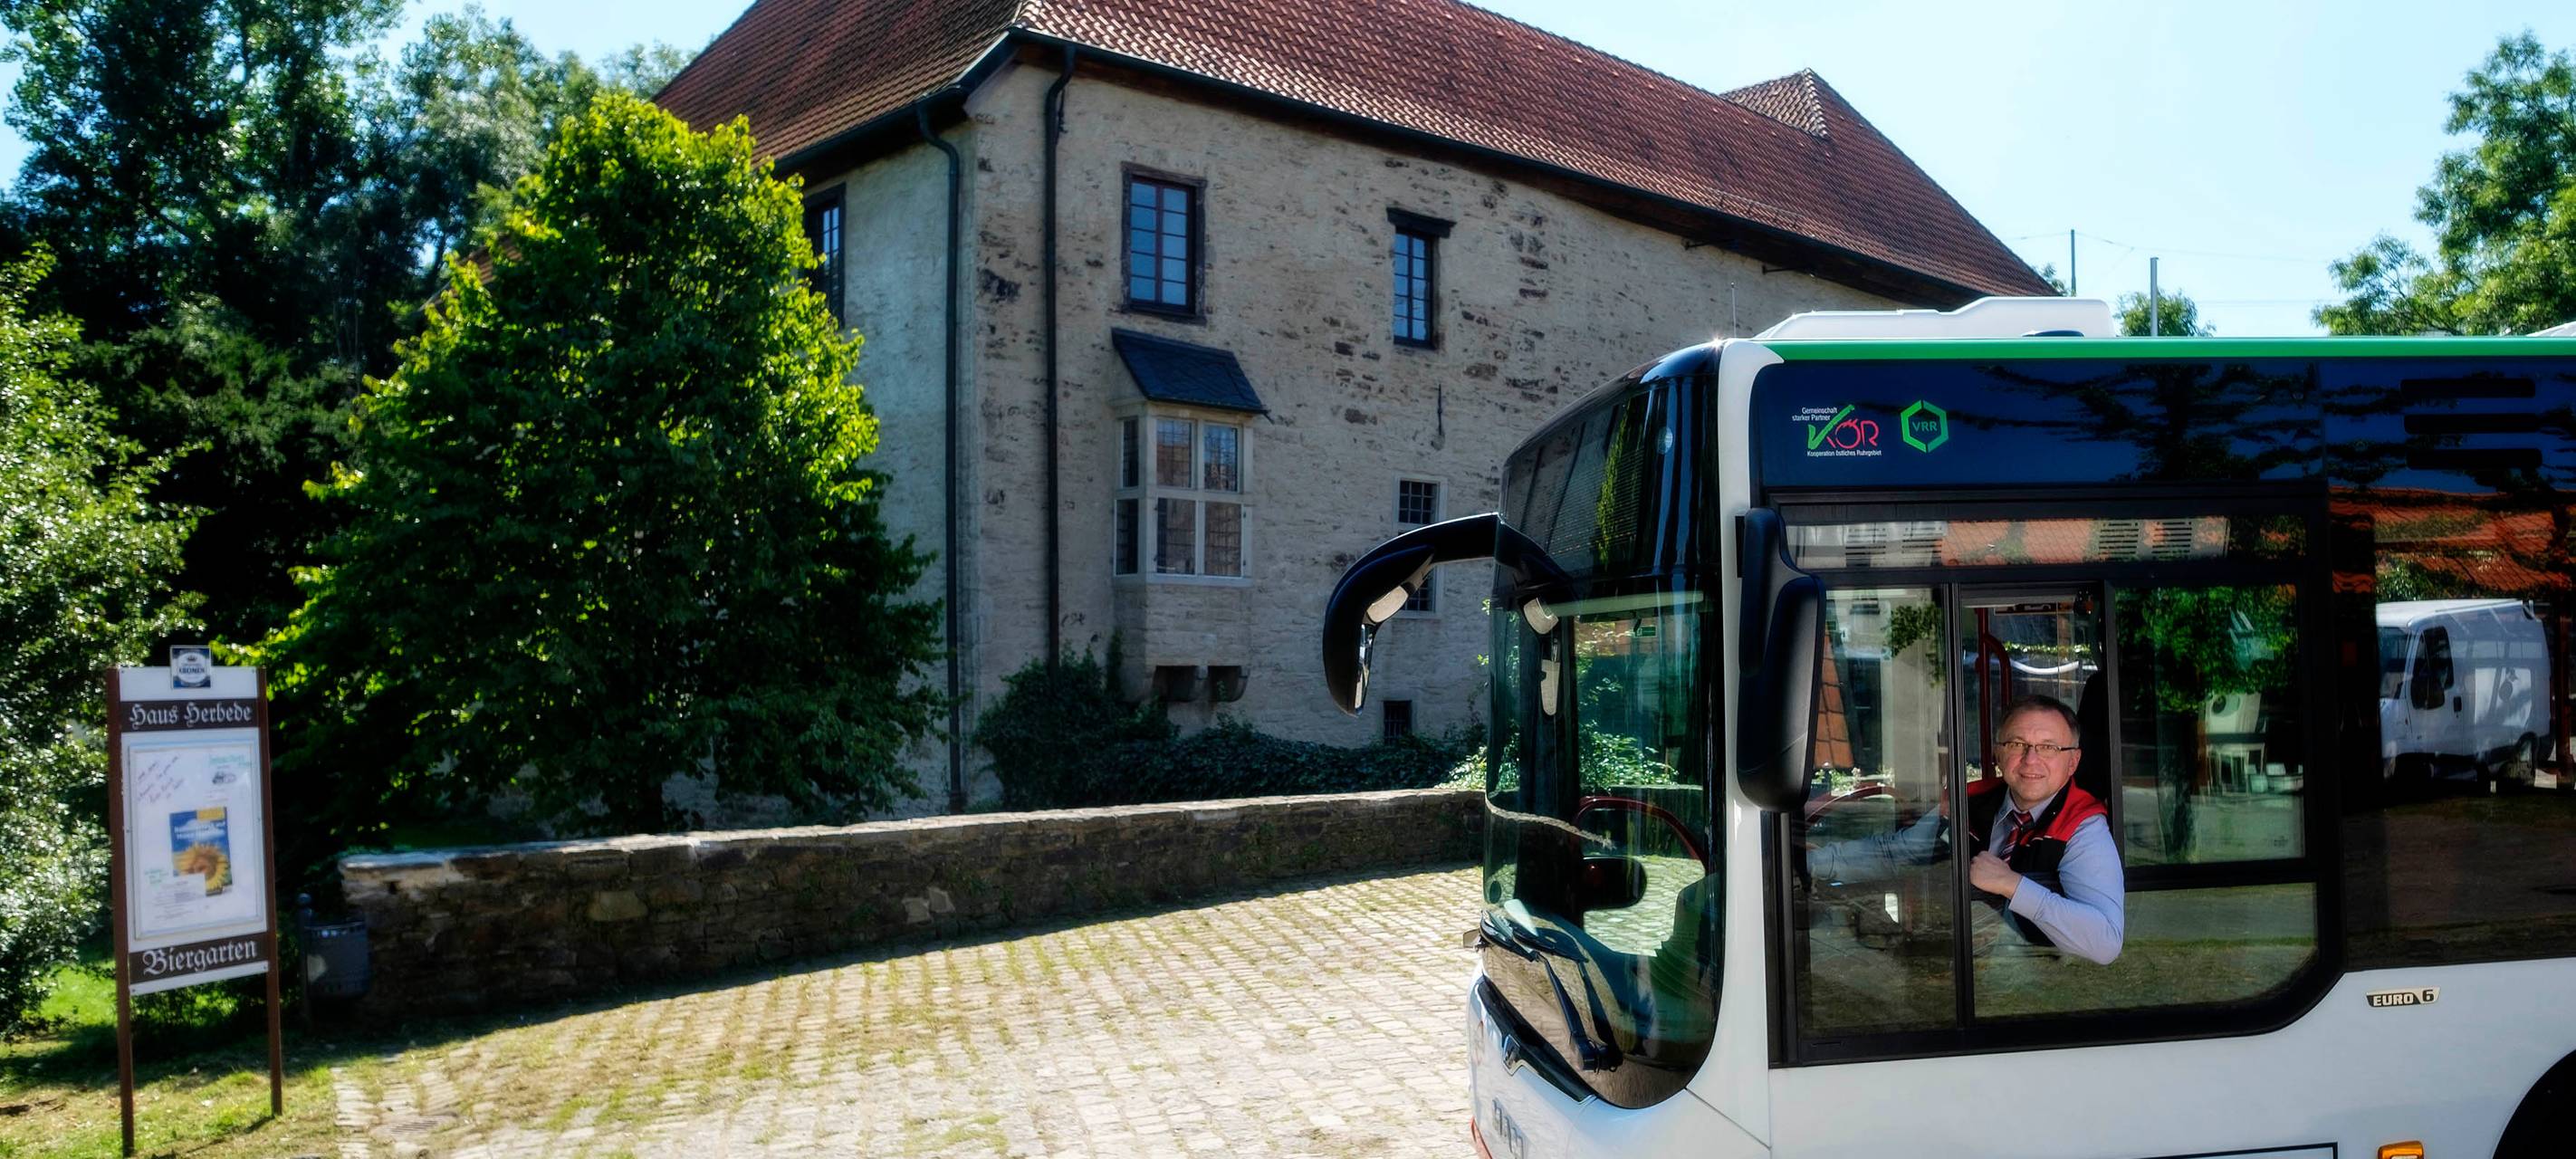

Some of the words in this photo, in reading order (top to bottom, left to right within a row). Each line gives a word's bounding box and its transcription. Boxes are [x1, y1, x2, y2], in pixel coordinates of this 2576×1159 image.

[1802, 407, 1838, 415] Gemeinschaft
[1912, 421, 1938, 432] VRR
[129, 703, 179, 731] Haus
[184, 701, 253, 728] Herbede
[142, 939, 258, 975] Biergarten
[2373, 993, 2414, 1007] EURO
[2422, 989, 2435, 1002] 6
